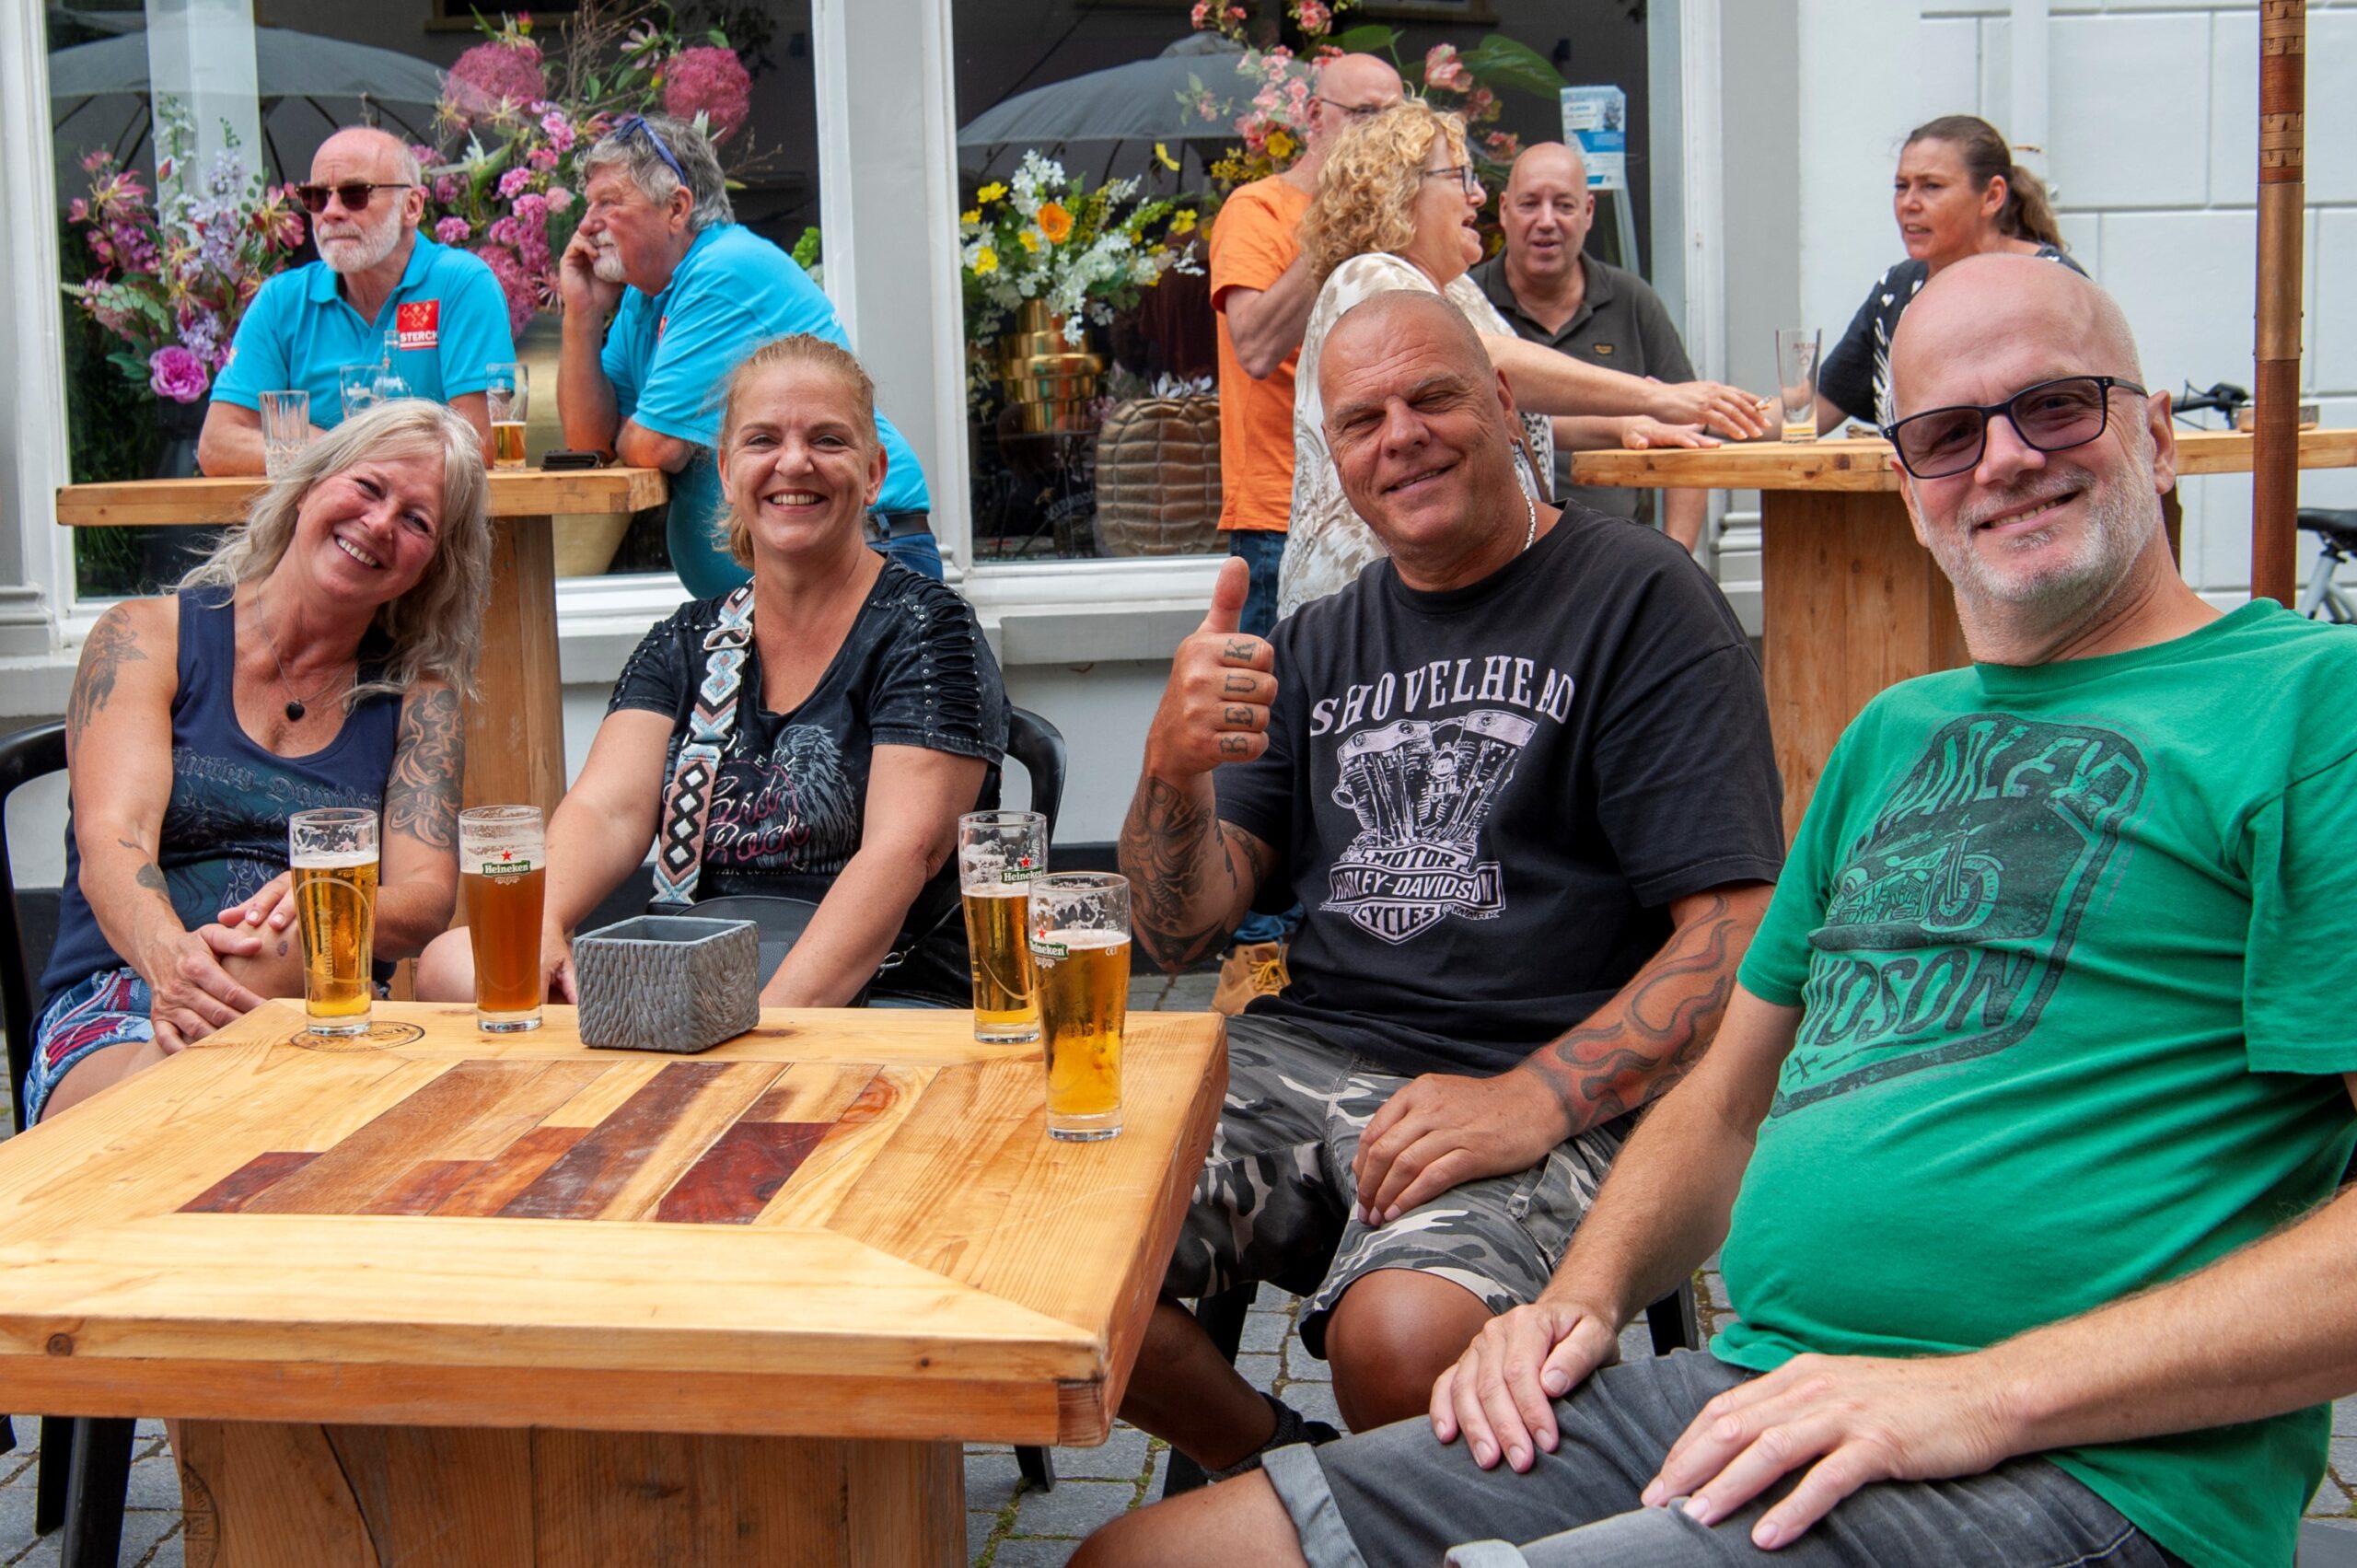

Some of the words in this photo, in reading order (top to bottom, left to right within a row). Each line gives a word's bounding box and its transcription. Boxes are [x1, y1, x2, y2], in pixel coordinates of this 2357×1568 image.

[1309, 655, 1575, 737] SHOVELHEAD
[484, 863, 529, 875] Heineken
[1370, 846, 1457, 868] MOTOR
[1332, 870, 1492, 902] HARLEY-DAVIDSON
[1358, 906, 1436, 936] CYCLES
